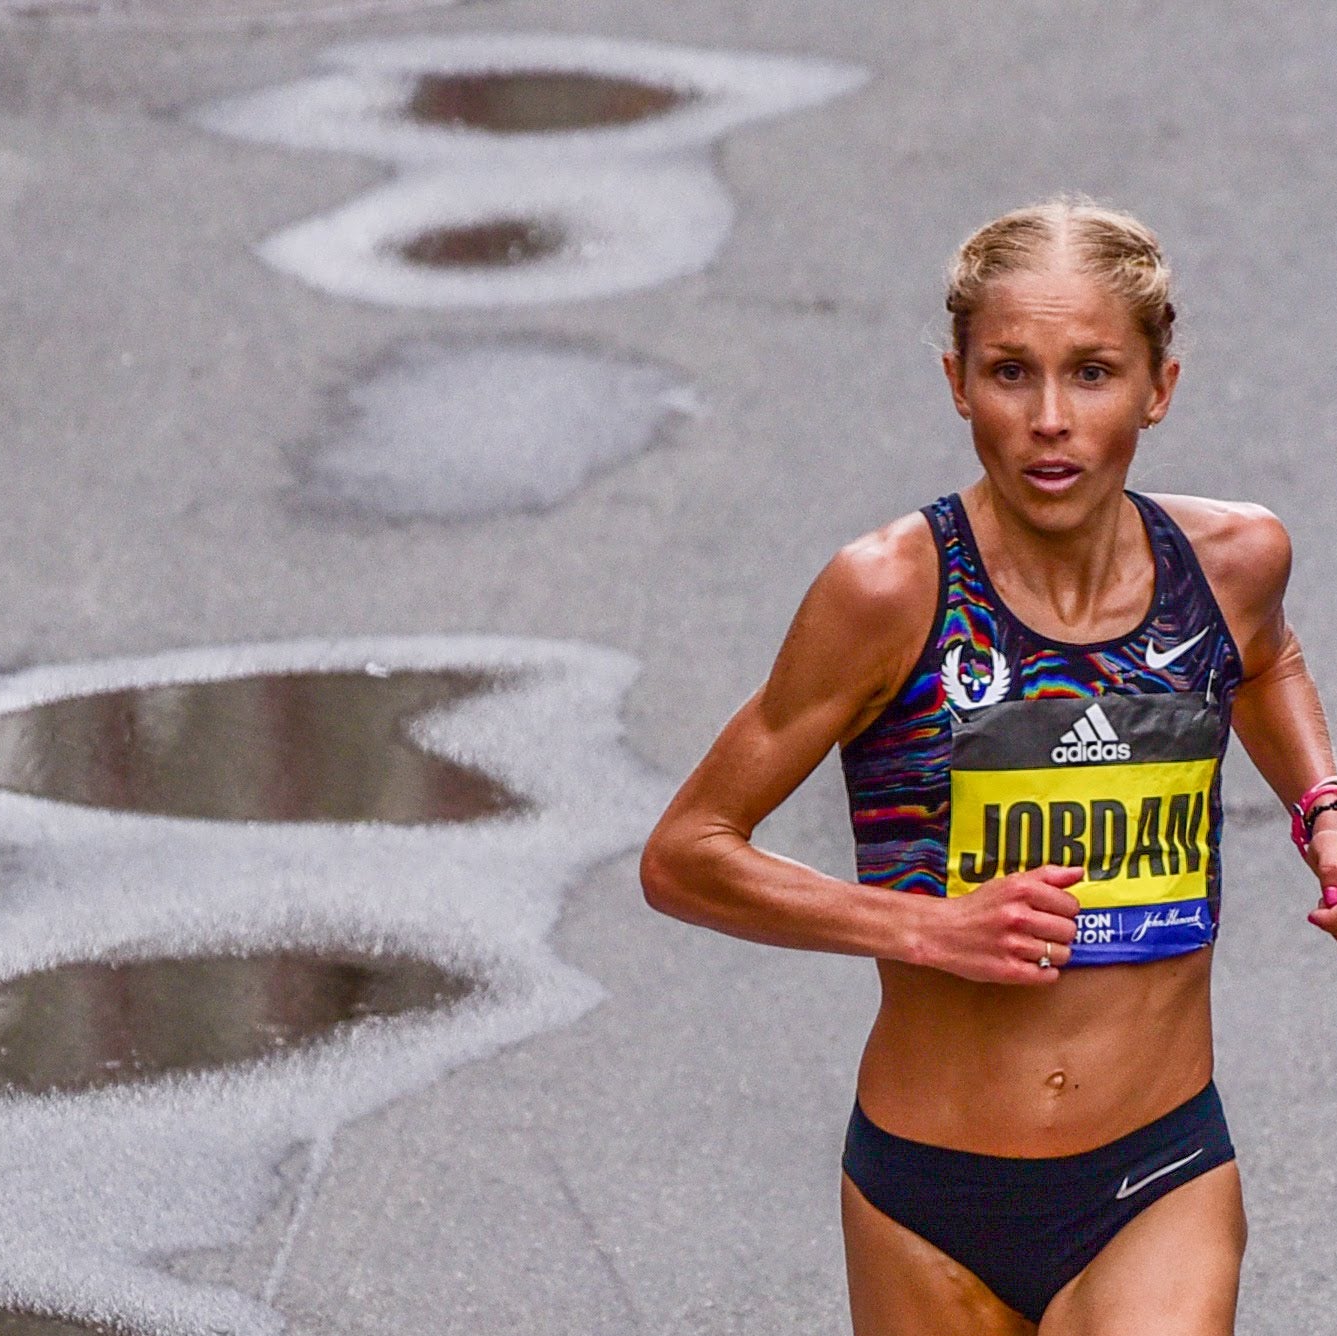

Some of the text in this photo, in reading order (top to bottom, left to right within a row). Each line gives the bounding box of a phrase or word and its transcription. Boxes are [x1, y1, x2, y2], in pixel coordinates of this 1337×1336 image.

[1051, 739, 1131, 763] adidas
[959, 791, 1204, 883] JORDAN
[1075, 913, 1111, 929] TON
